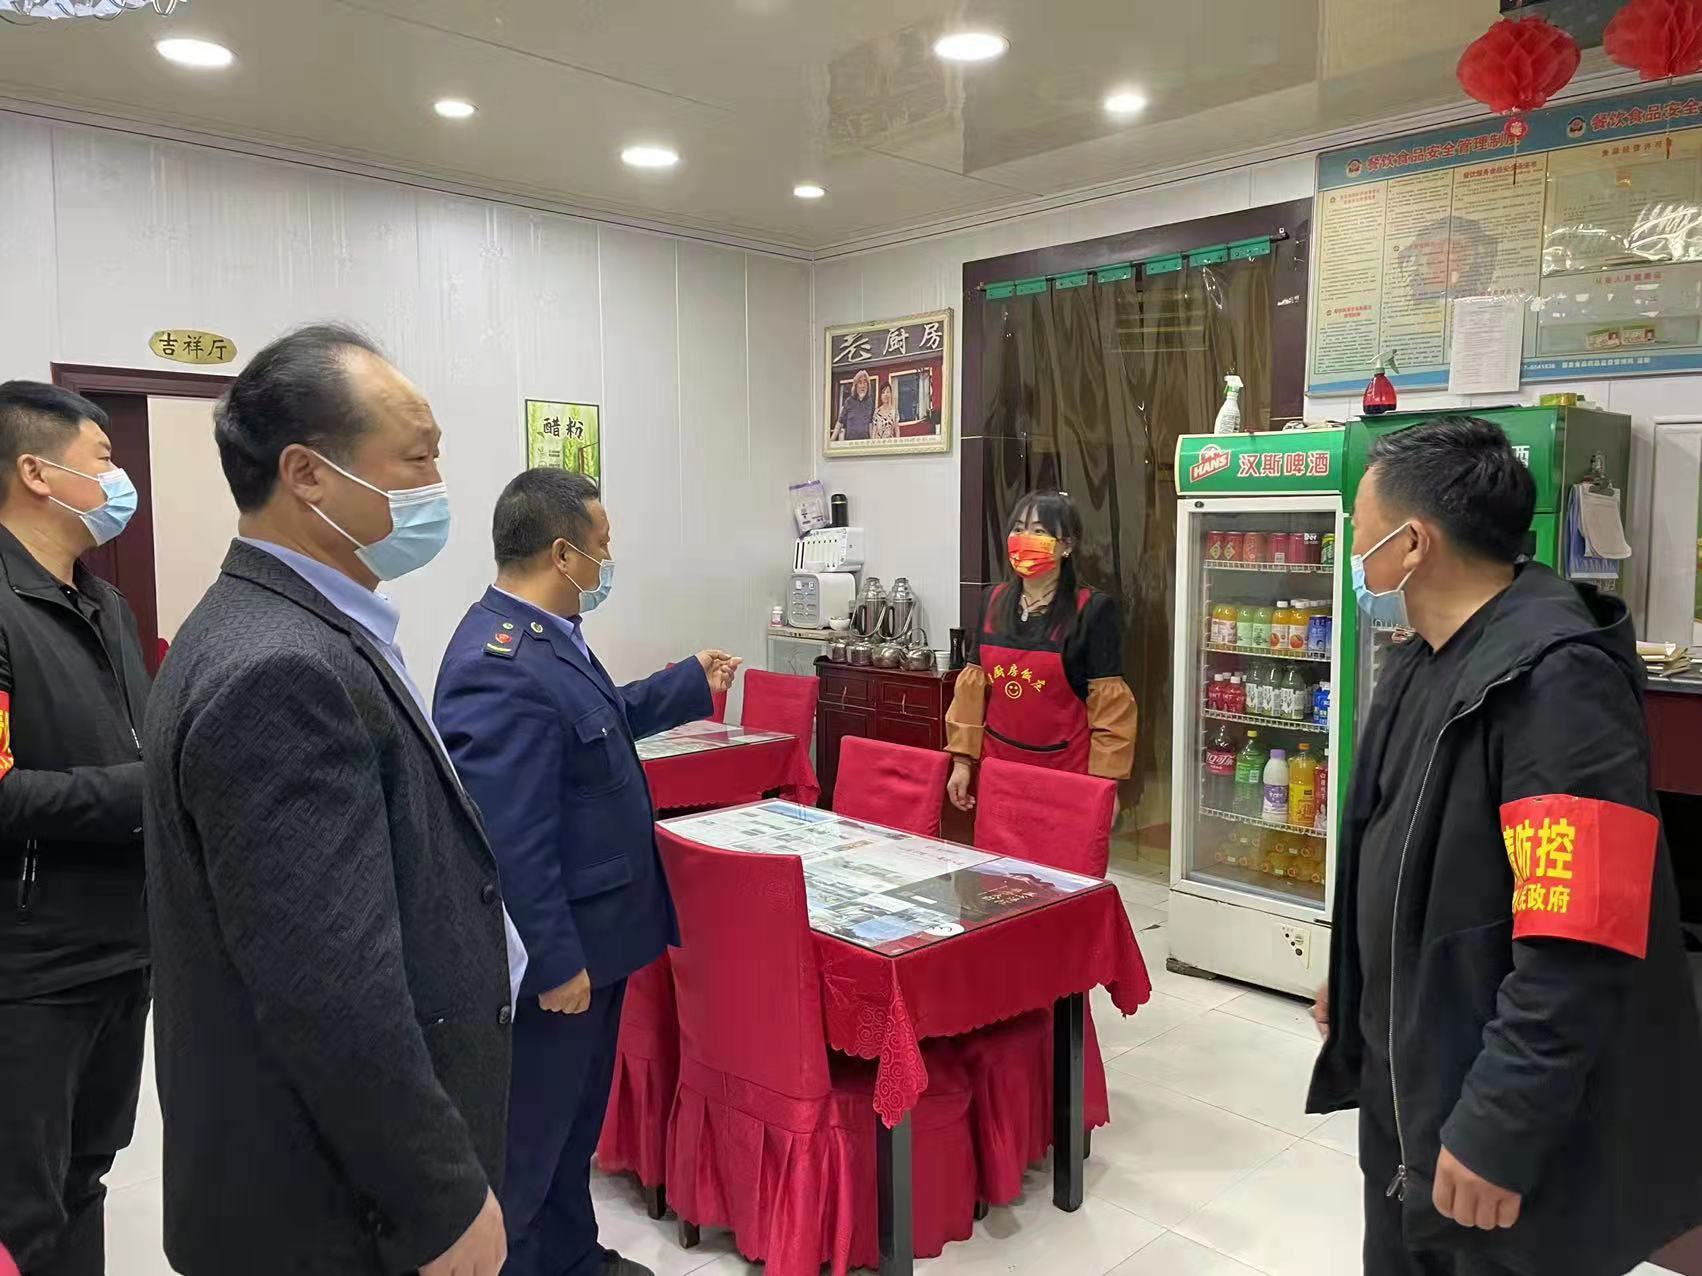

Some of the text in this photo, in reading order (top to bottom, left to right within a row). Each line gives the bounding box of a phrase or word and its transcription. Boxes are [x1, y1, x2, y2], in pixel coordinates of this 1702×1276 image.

[1590, 97, 1702, 132] 餐饮食品安全
[159, 332, 227, 361] 吉祥厅
[833, 322, 943, 363] 老厨房
[543, 416, 584, 439] 醋粉
[1193, 454, 1229, 479] HANS
[1237, 451, 1330, 477] 汉斯啤酒
